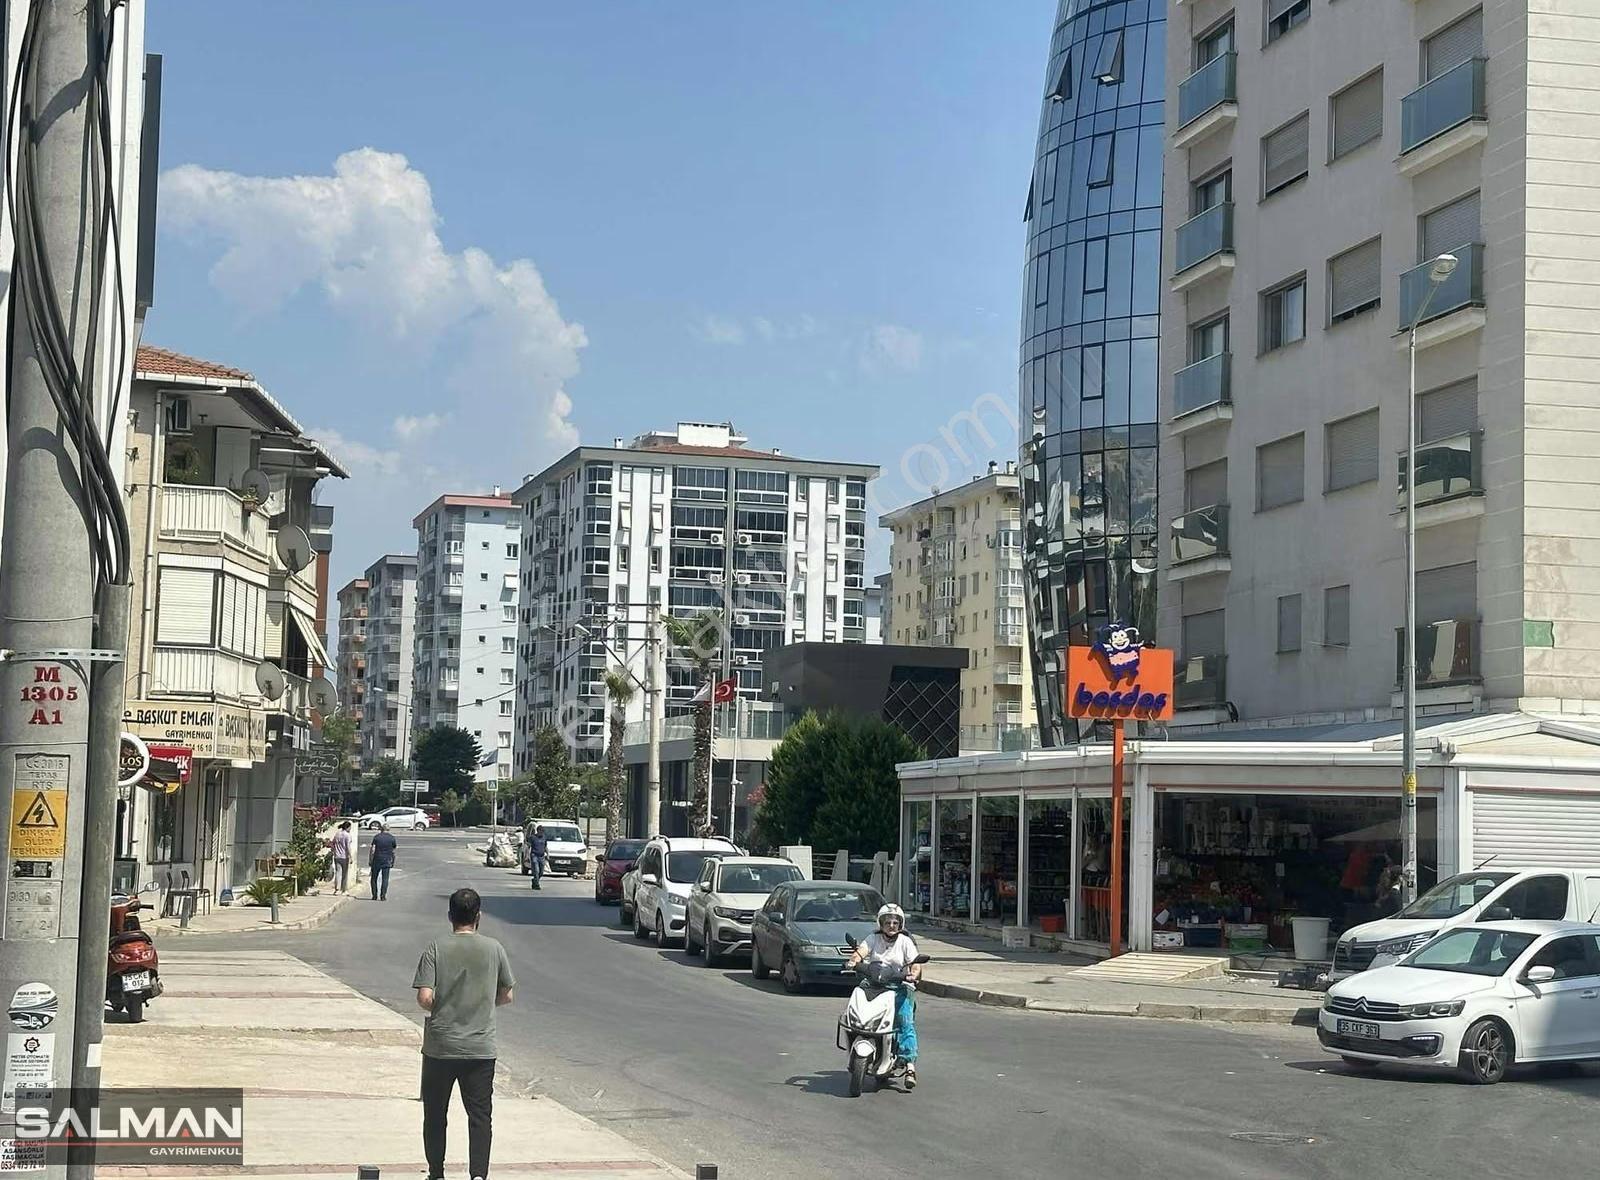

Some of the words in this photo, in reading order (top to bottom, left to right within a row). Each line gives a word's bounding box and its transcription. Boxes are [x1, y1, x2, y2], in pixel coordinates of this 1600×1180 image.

[34, 666, 61, 682] M
[20, 686, 78, 702] 1305
[28, 709, 63, 725] A1
[180, 711, 214, 727] EMLAK
